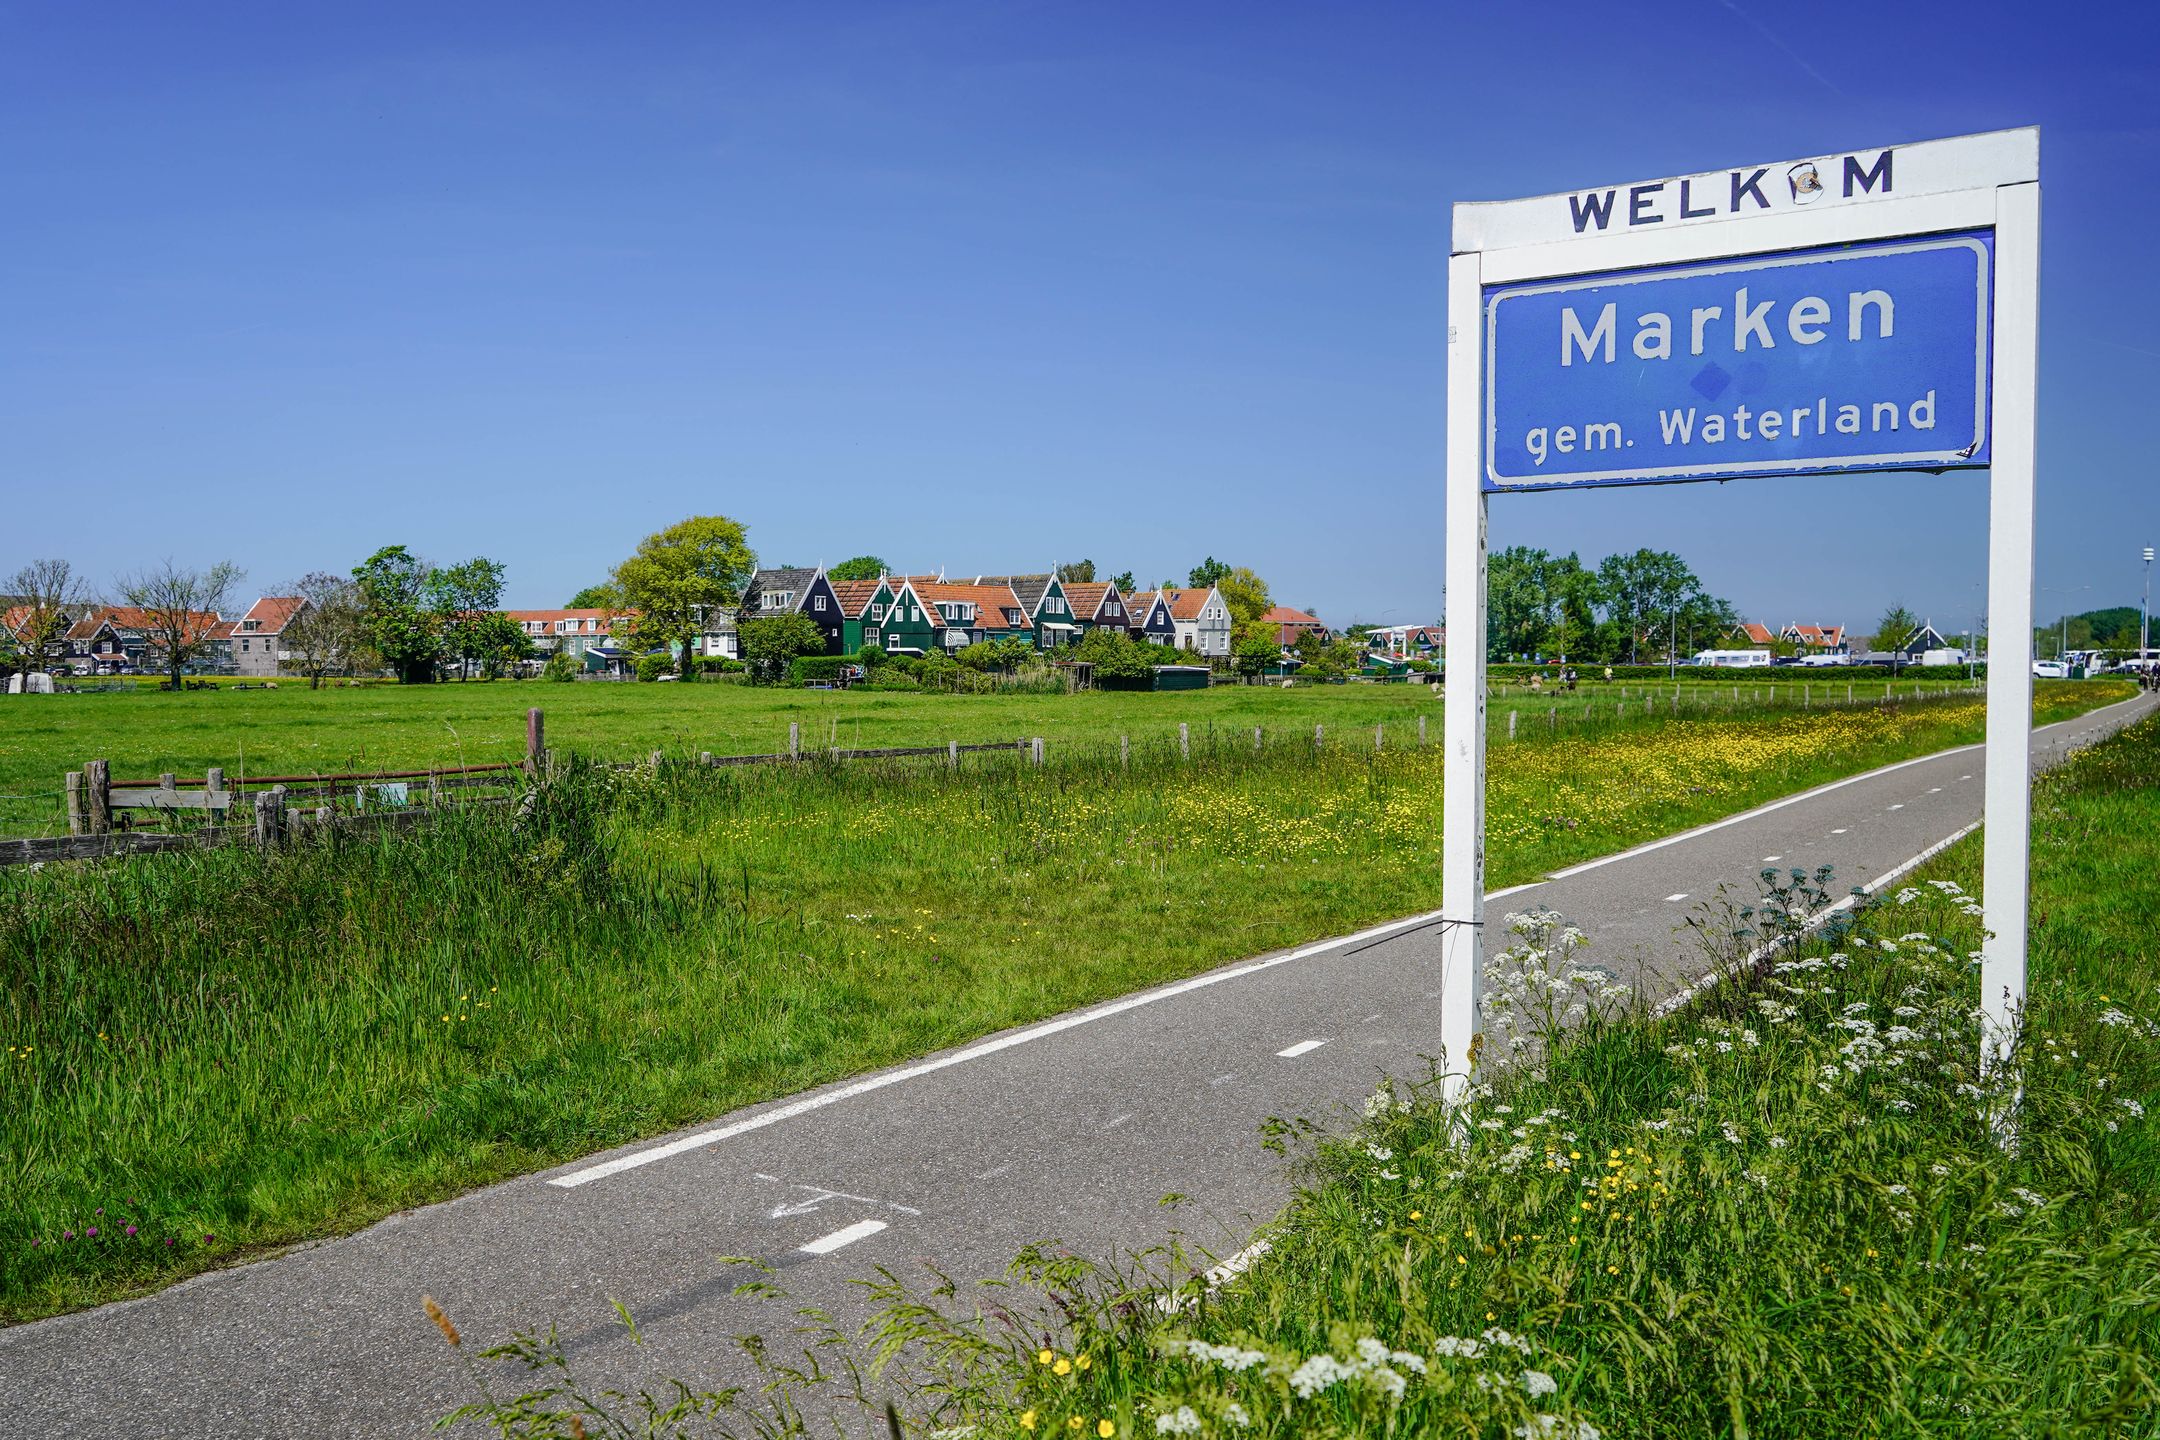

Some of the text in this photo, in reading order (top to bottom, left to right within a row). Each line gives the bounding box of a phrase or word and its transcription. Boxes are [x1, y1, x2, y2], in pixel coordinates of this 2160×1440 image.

[1560, 287, 1895, 367] Marken
[1526, 389, 1936, 466] gem. Waterland
